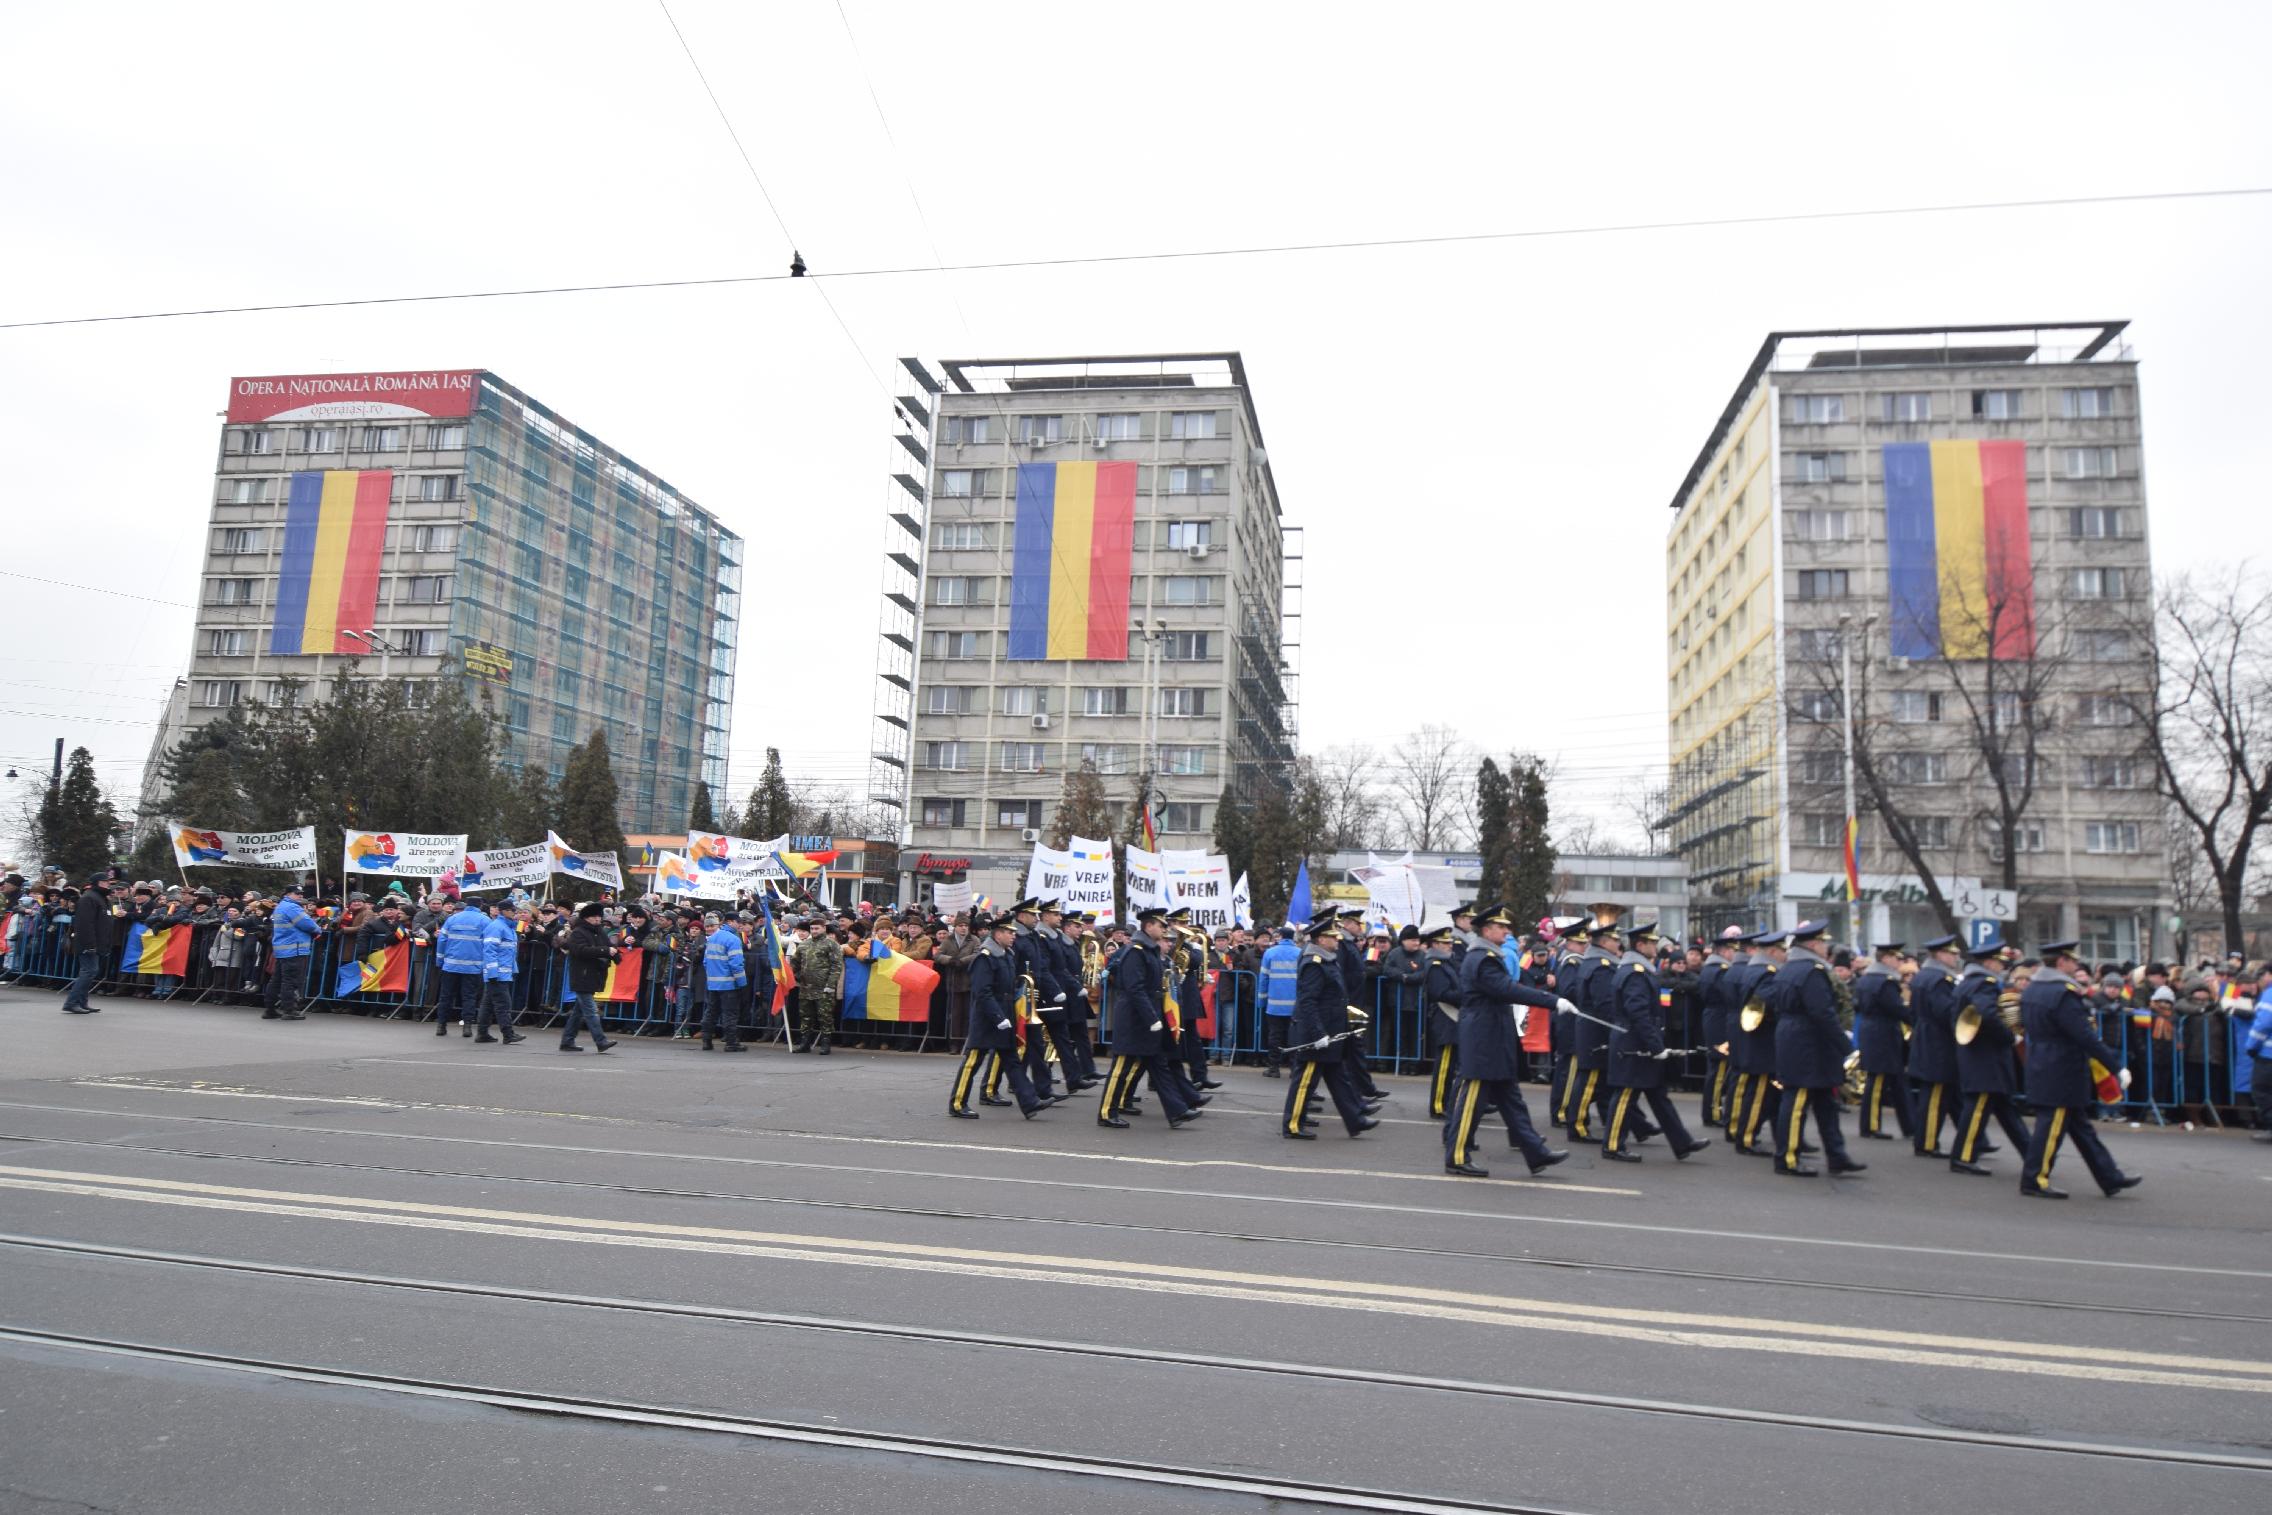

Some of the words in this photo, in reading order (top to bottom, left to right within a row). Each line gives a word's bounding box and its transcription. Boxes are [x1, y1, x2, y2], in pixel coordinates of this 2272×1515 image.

[374, 373, 439, 391] ROMÂNĂ
[235, 830, 303, 845] MOLDOVA
[407, 836, 459, 846] MOLDOVA
[238, 846, 259, 854] are
[259, 842, 300, 854] nevoie
[426, 848, 454, 856] nevoie
[484, 844, 547, 862] MOLDOVA
[489, 862, 508, 871] are
[508, 855, 544, 868] nevoie
[1075, 871, 1109, 884] VREM
[1127, 869, 1156, 895] VREM
[1068, 889, 1113, 903] UNIREA
[1176, 880, 1219, 898] VREM
[1978, 922, 1994, 944] P
